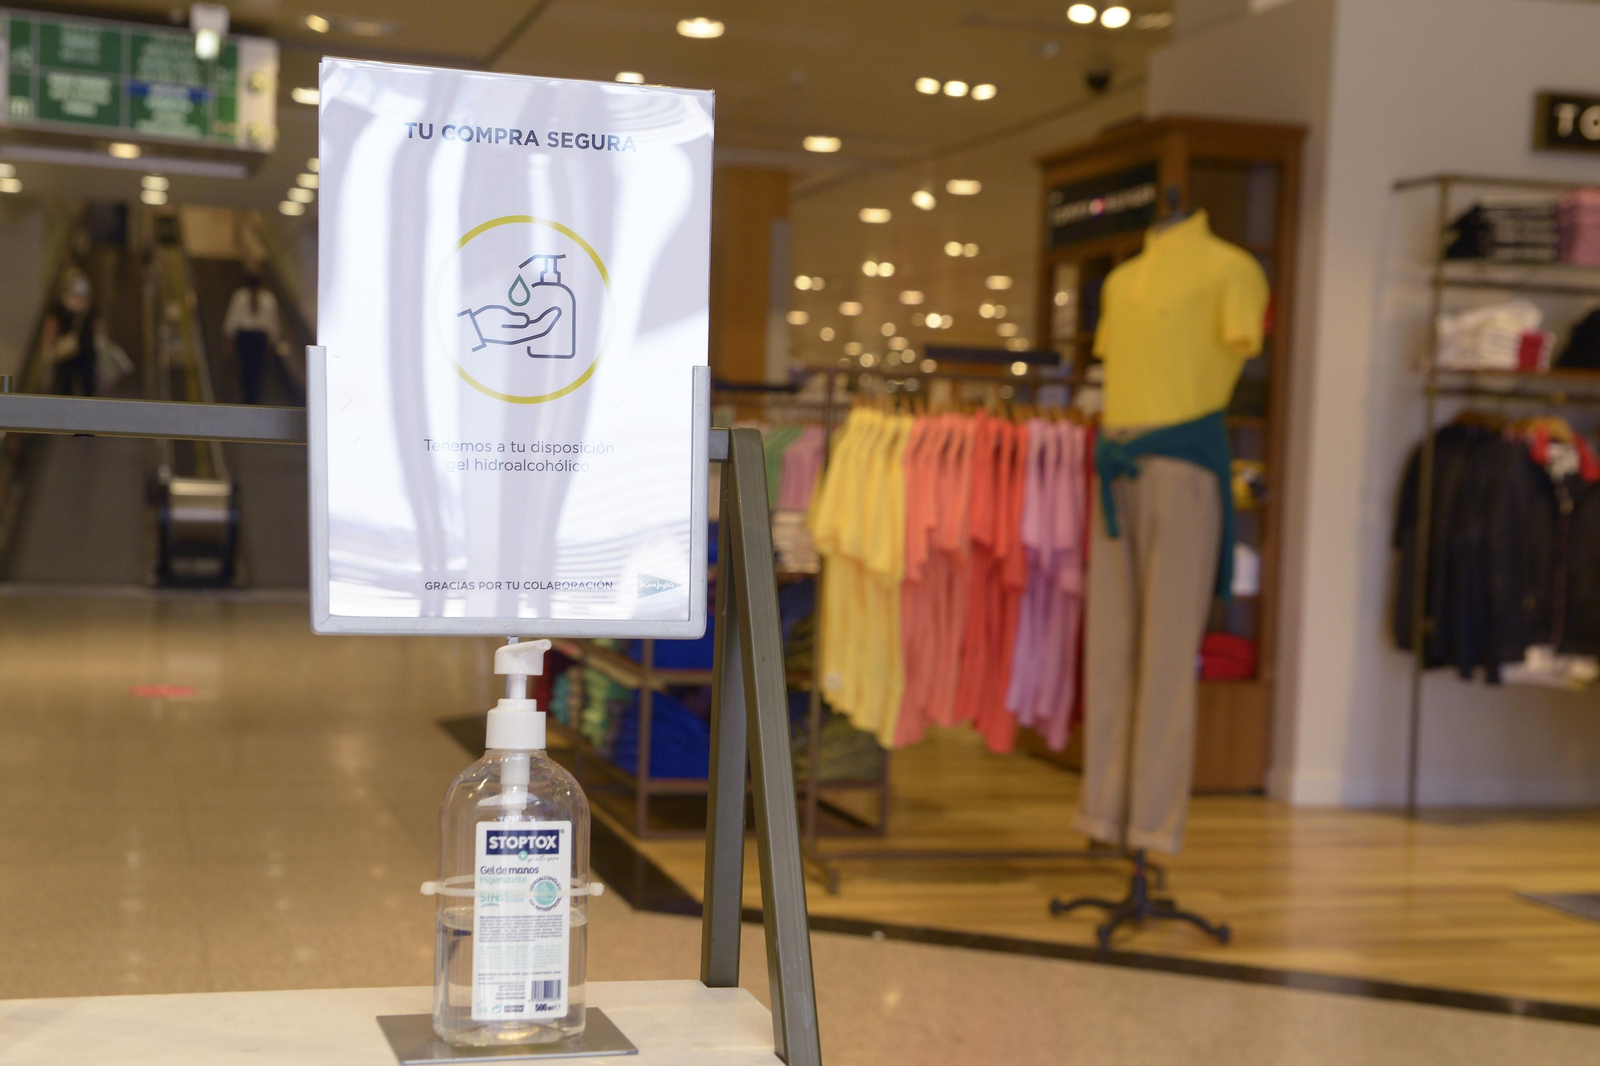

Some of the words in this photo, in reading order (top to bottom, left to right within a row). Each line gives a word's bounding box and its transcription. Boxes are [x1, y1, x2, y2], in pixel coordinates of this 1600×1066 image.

[404, 121, 434, 140] TU
[441, 124, 540, 147] COMPRA
[546, 130, 637, 153] SEGURA
[423, 438, 492, 453] Tenemos
[496, 443, 506, 453] a
[510, 440, 526, 453] tu
[530, 440, 615, 456] disposición
[446, 458, 469, 473] gel
[424, 581, 476, 591] GRACIAS
[478, 581, 502, 591] POR
[504, 581, 520, 591] TU
[523, 578, 613, 591] COLABORACIÓN
[488, 835, 557, 850] STOPTOX
[480, 865, 495, 875] Gel
[495, 865, 508, 875] de
[508, 866, 539, 875] manos
[480, 875, 527, 885] Higienizante
